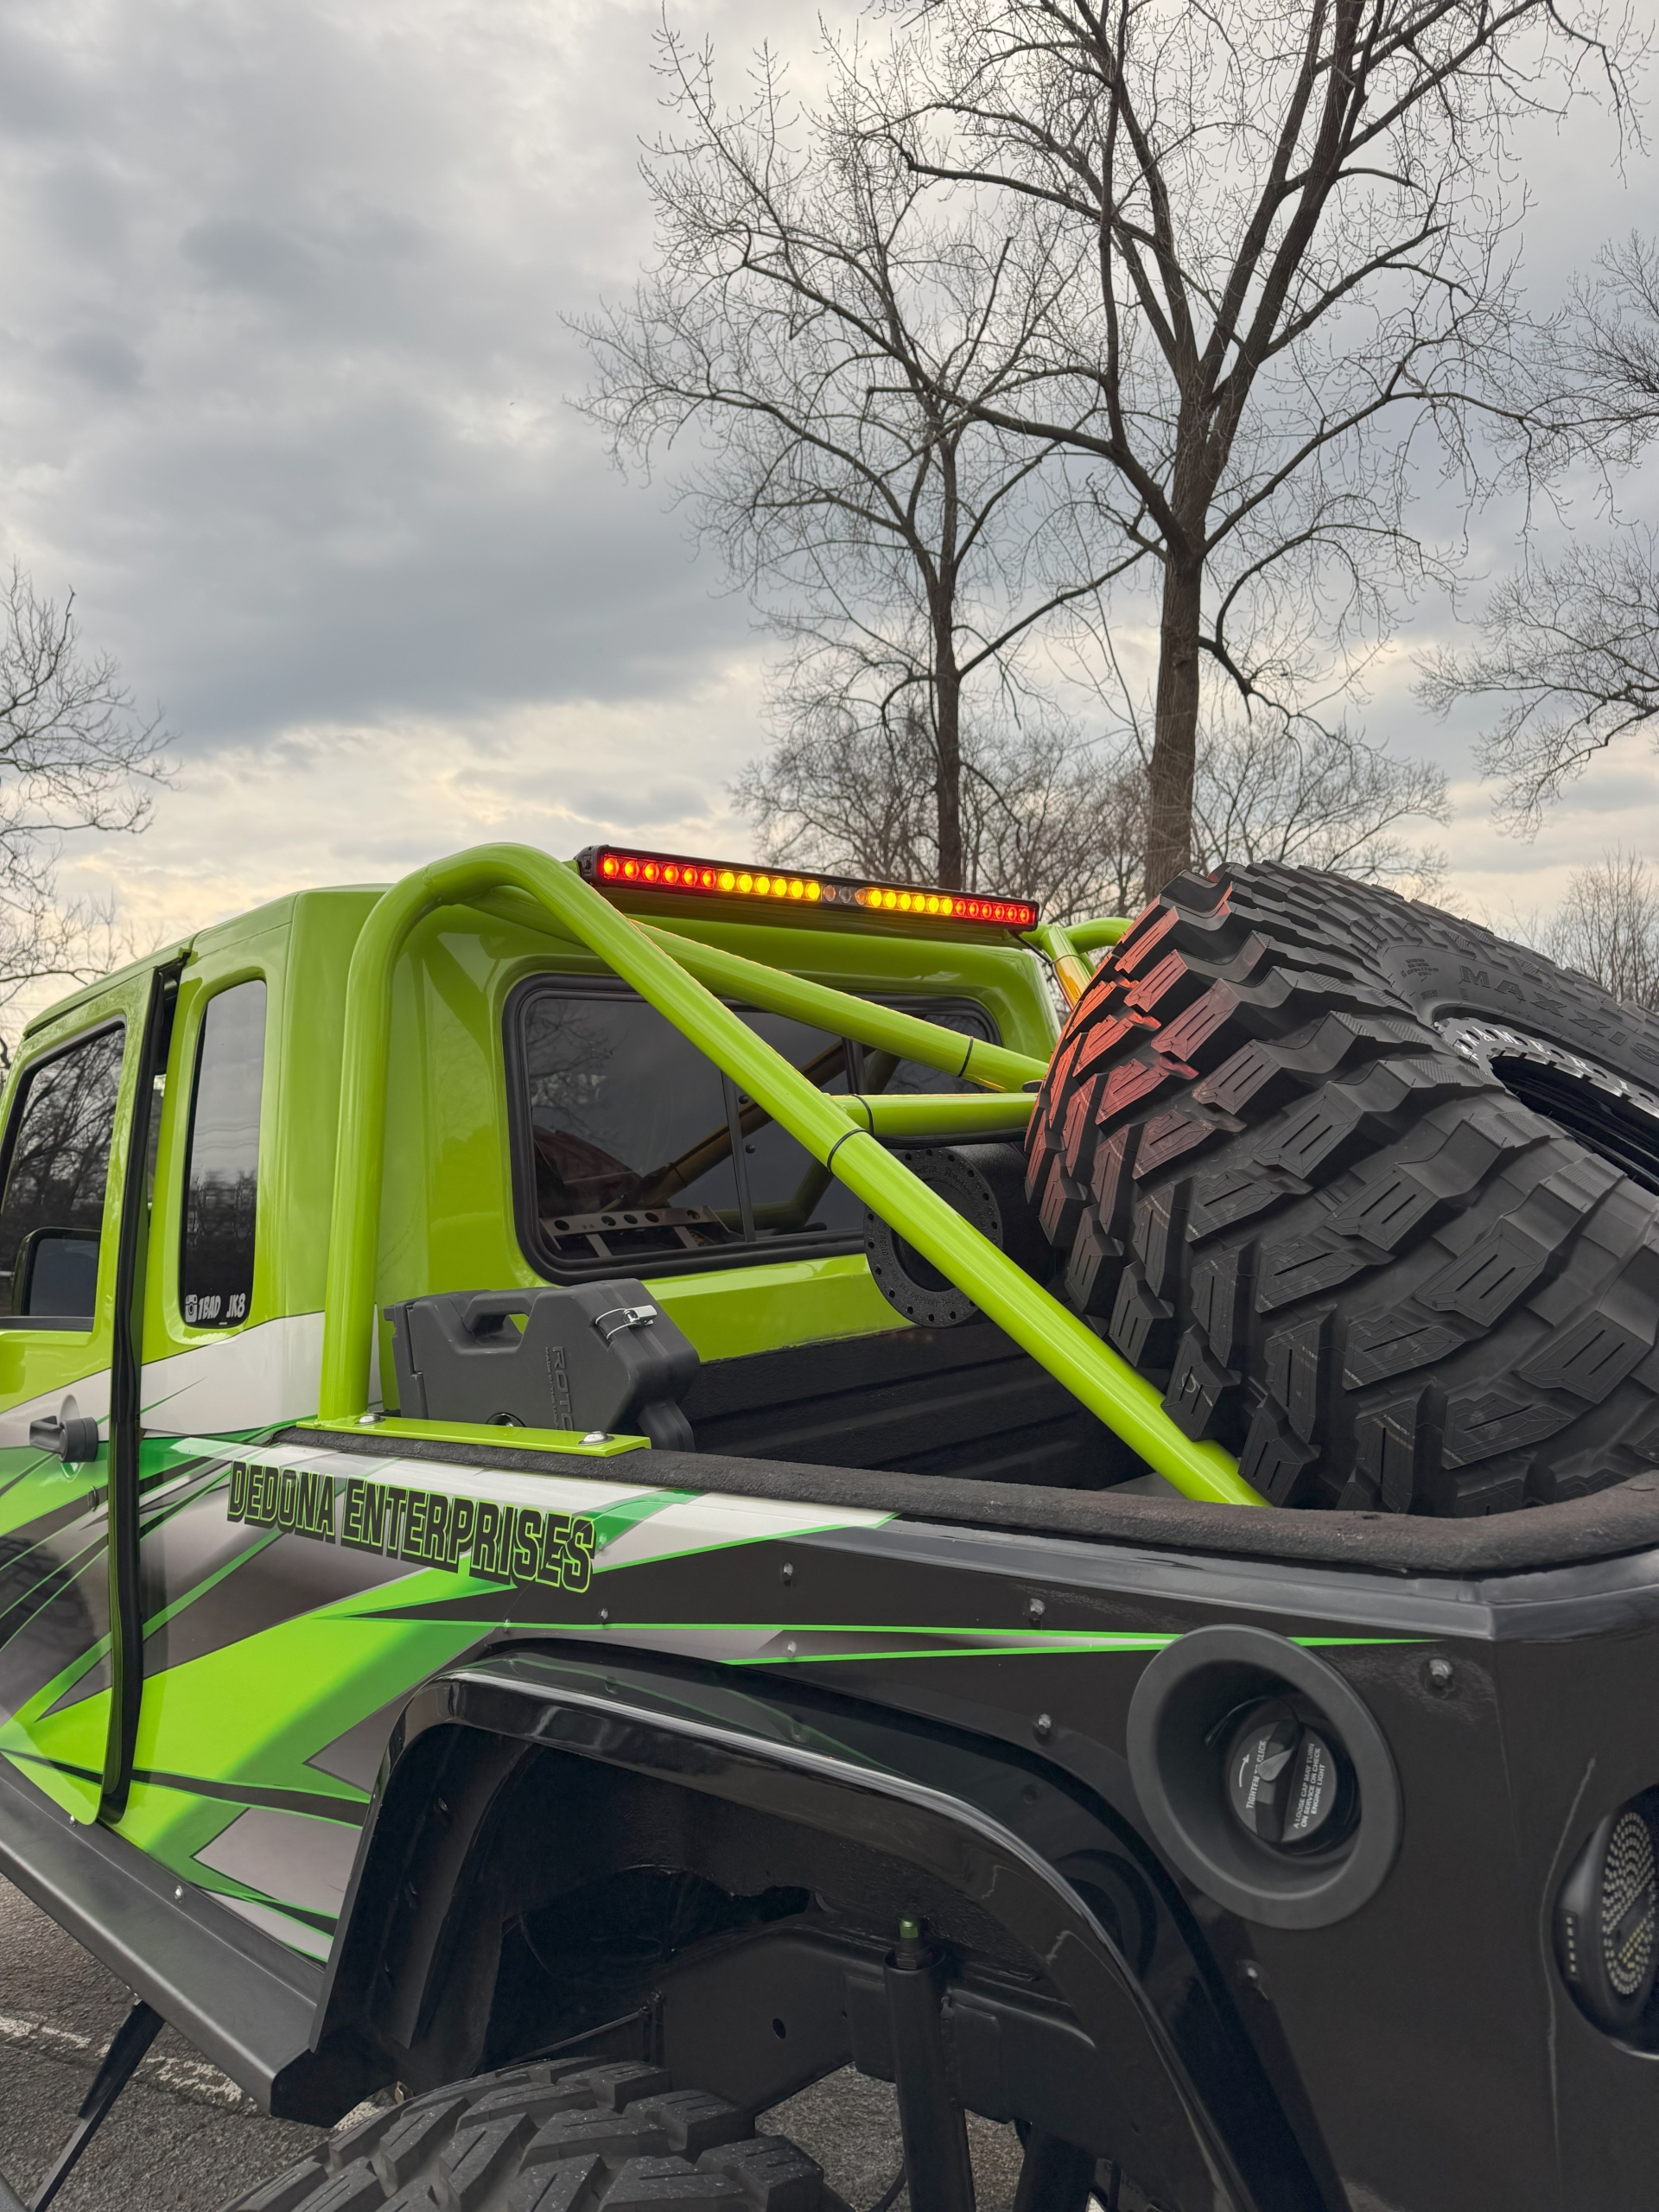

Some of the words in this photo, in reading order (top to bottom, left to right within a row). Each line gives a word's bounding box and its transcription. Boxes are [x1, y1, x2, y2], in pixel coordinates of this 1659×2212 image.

[1459, 965, 1659, 1067] MAXXIS
[227, 1459, 336, 1544] DEDONA
[341, 1475, 596, 1593] ENTERPRISES
[1246, 1776, 1260, 1808] TIGHTEN
[1256, 1740, 1267, 1763] CLICK
[1313, 1748, 1321, 1772] CHECK
[1310, 1773, 1317, 1784] OR
[1311, 1787, 1321, 1815] ENGINE
[1317, 1764, 1325, 1785] LIGHT
[1294, 1797, 1305, 1821] LOOSE
[1304, 1785, 1314, 1815] SERVICE
[1300, 1815, 1309, 1827] ON
